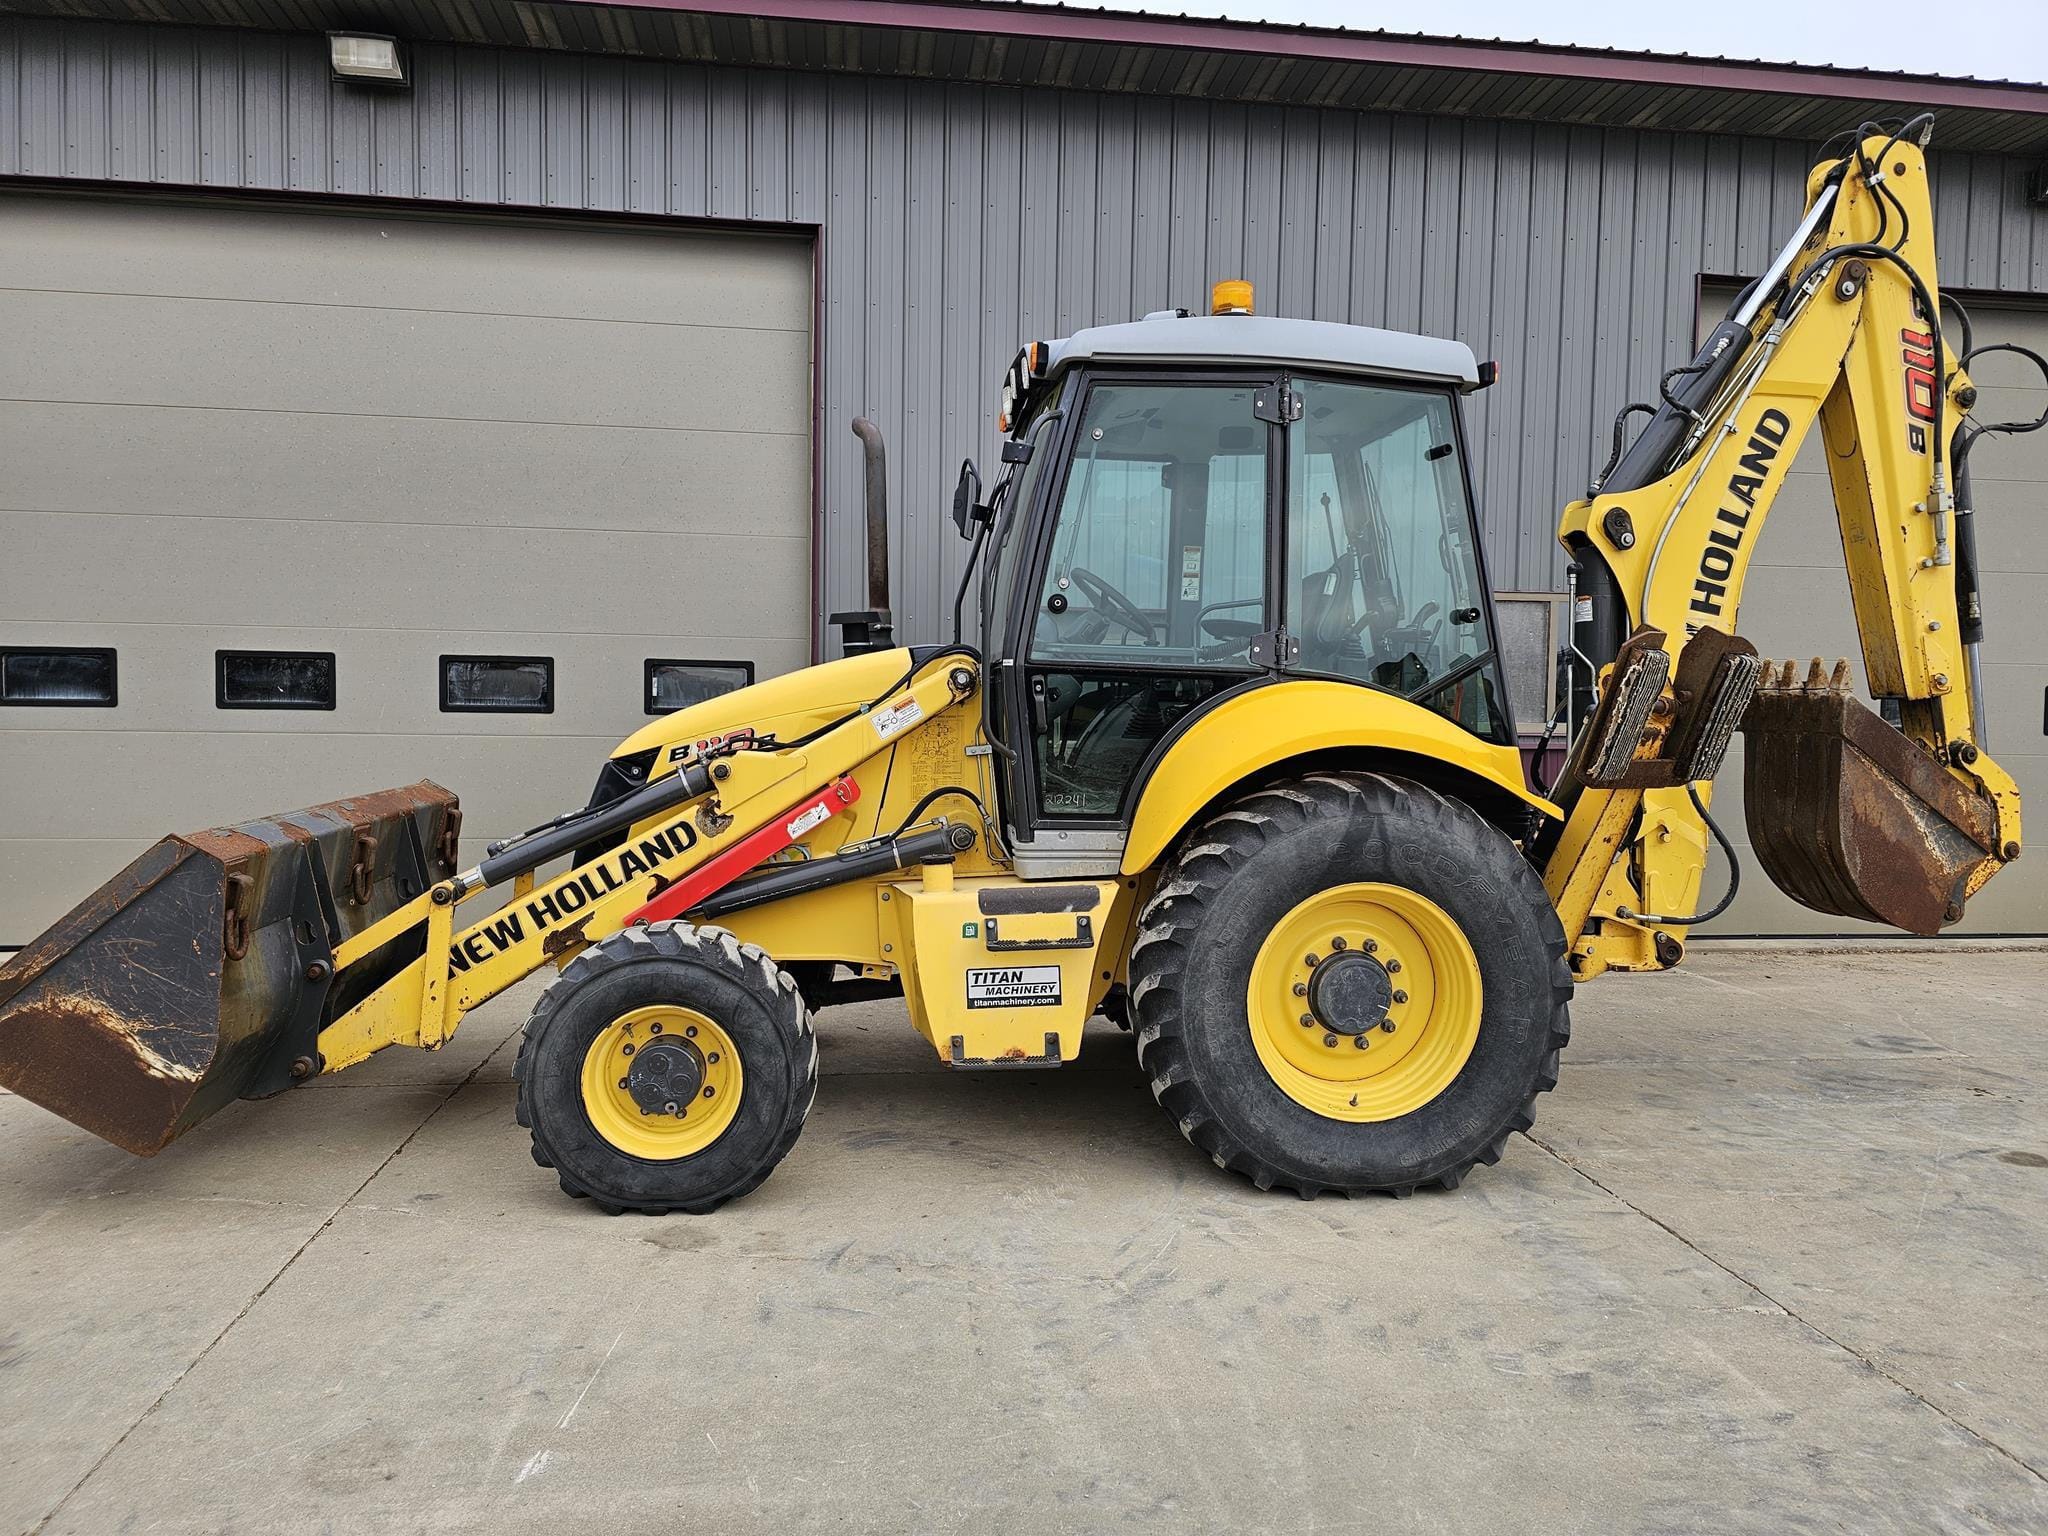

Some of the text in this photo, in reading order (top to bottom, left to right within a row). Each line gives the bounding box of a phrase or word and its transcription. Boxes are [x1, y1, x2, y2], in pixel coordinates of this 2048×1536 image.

[1690, 408, 1791, 617] HOLLAND
[447, 911, 525, 981] NEW
[526, 820, 698, 930] HOLLAND
[972, 970, 1024, 985] TITAN
[985, 984, 1056, 996] MACHINERY
[973, 997, 1056, 1007] titanmachinery.com
